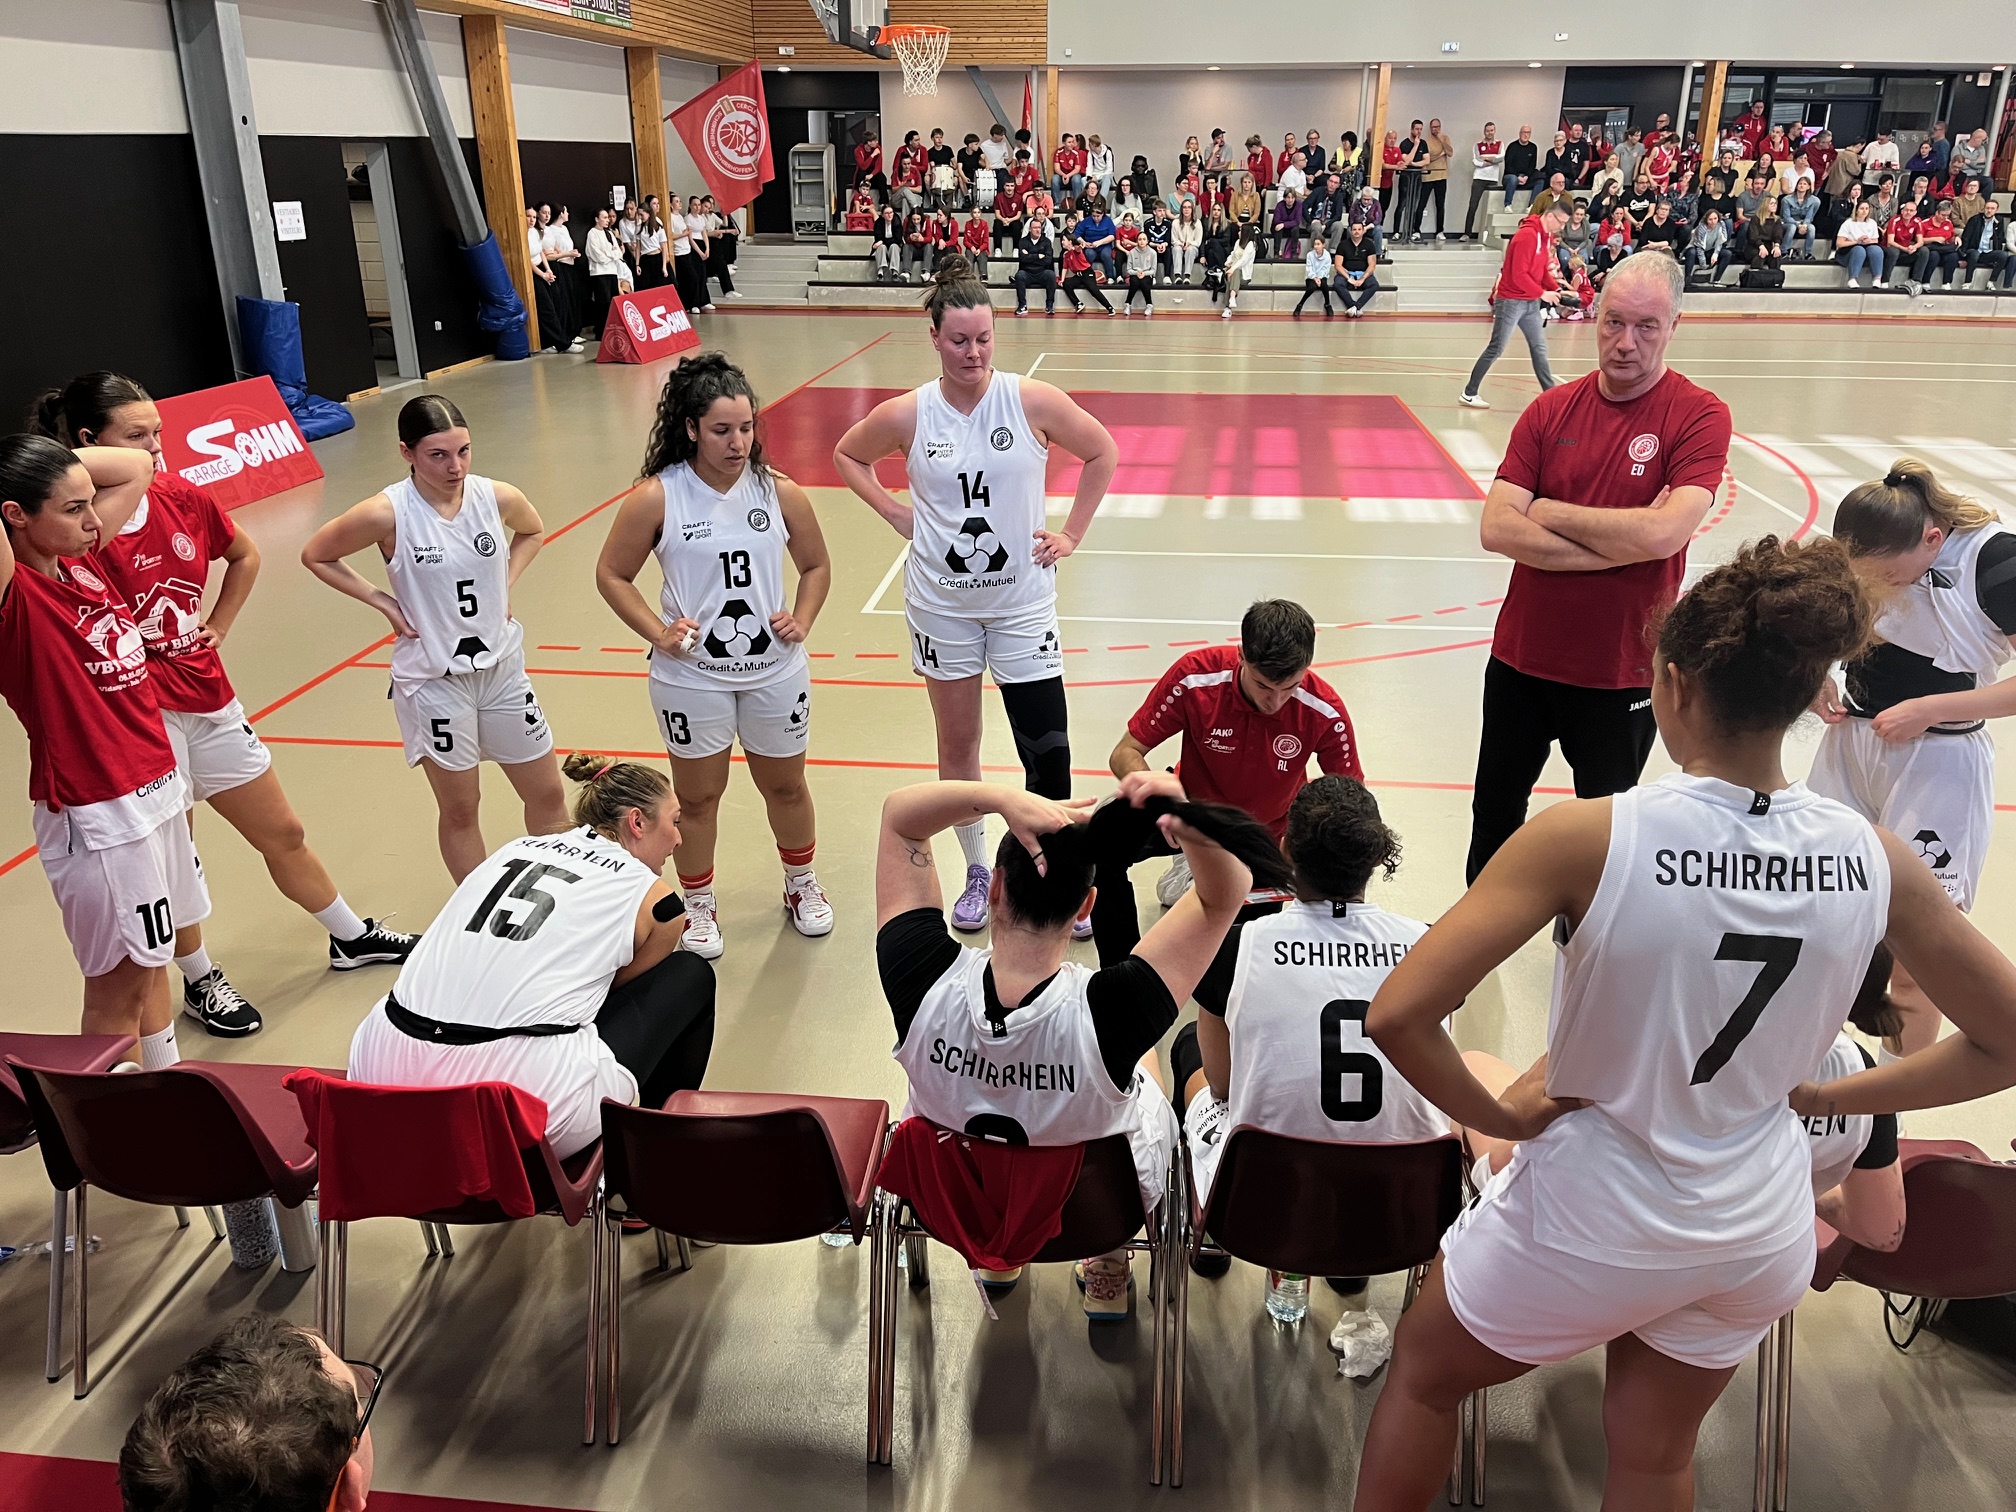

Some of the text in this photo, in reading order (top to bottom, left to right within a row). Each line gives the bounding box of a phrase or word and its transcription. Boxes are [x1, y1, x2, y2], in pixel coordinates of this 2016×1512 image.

[184, 458, 235, 484] GARAGE
[1630, 463, 1645, 476] ED
[957, 471, 990, 508] 14
[682, 521, 706, 530] CRAFT
[719, 550, 752, 590] 13
[938, 575, 1016, 589] Crédit Mutuel
[456, 579, 478, 618] 5
[697, 661, 731, 672] Crédit
[914, 633, 939, 668] 14
[1628, 698, 1652, 711] JAKO
[431, 718, 453, 753] 5
[662, 709, 692, 745] 13
[1210, 728, 1234, 737] JAKO
[1277, 759, 1289, 771] RL
[1655, 849, 1869, 892] SCHIRRHEIN
[464, 858, 583, 941] 15
[135, 897, 173, 950] 10
[1689, 932, 1803, 1086] 7
[929, 1037, 1075, 1093] SCHIRRHEIN
[1320, 999, 1384, 1122] 6
